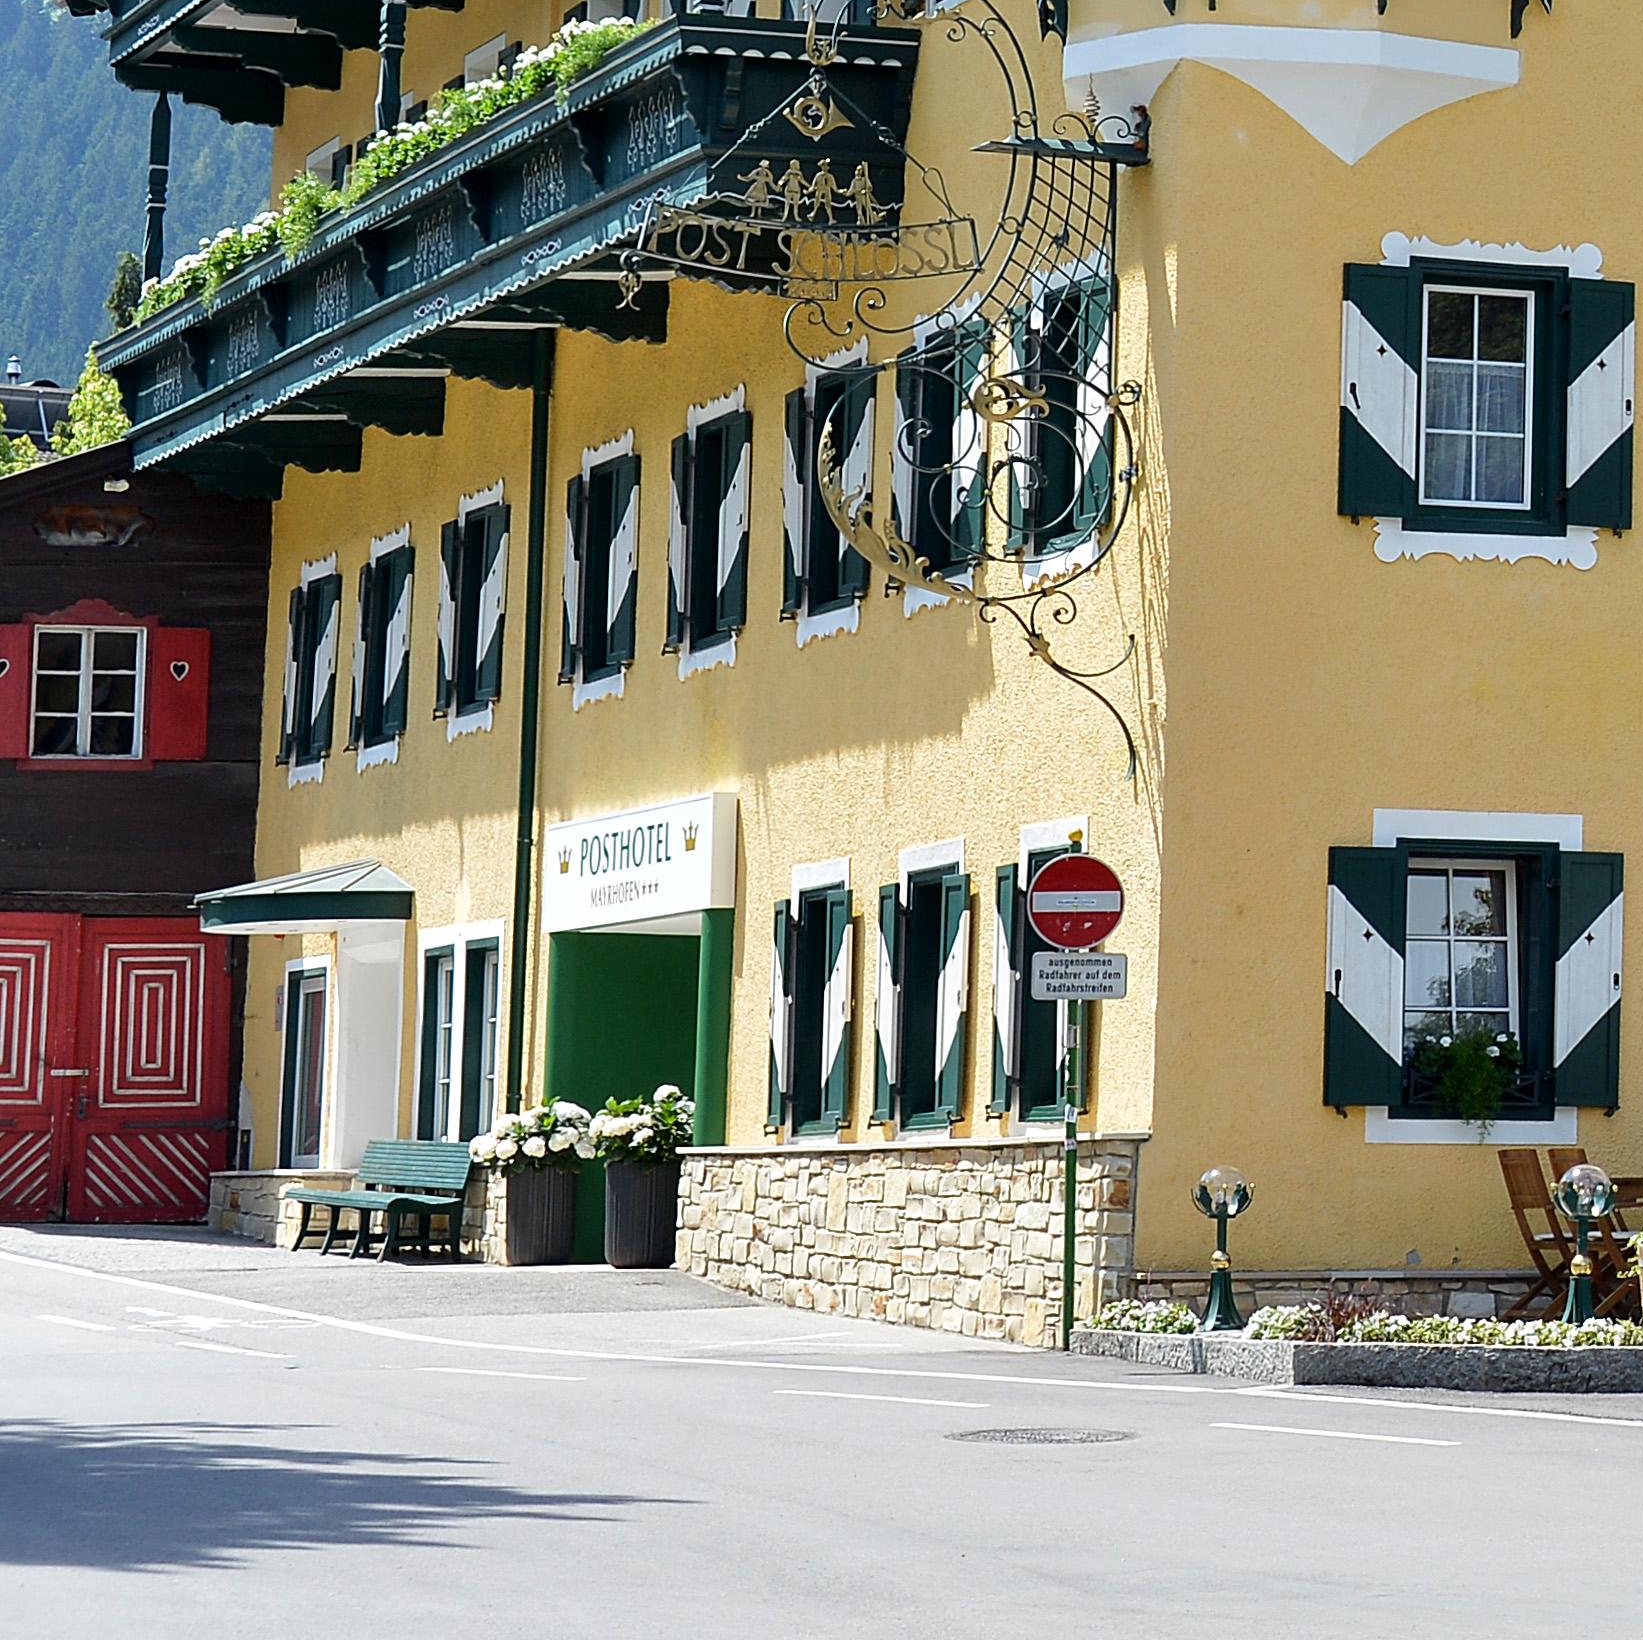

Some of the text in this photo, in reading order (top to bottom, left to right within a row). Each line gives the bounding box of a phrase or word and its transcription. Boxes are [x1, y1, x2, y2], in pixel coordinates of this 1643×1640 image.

[648, 209, 975, 279] POST SCHLÖSSL
[580, 821, 671, 877] POSTHOTEL
[590, 880, 640, 908] MAYRHOFEN
[1048, 958, 1113, 969] ausgenommen
[1039, 969, 1121, 980] Radfahrer auf dem
[1046, 982, 1113, 993] Radfahrstreifen
